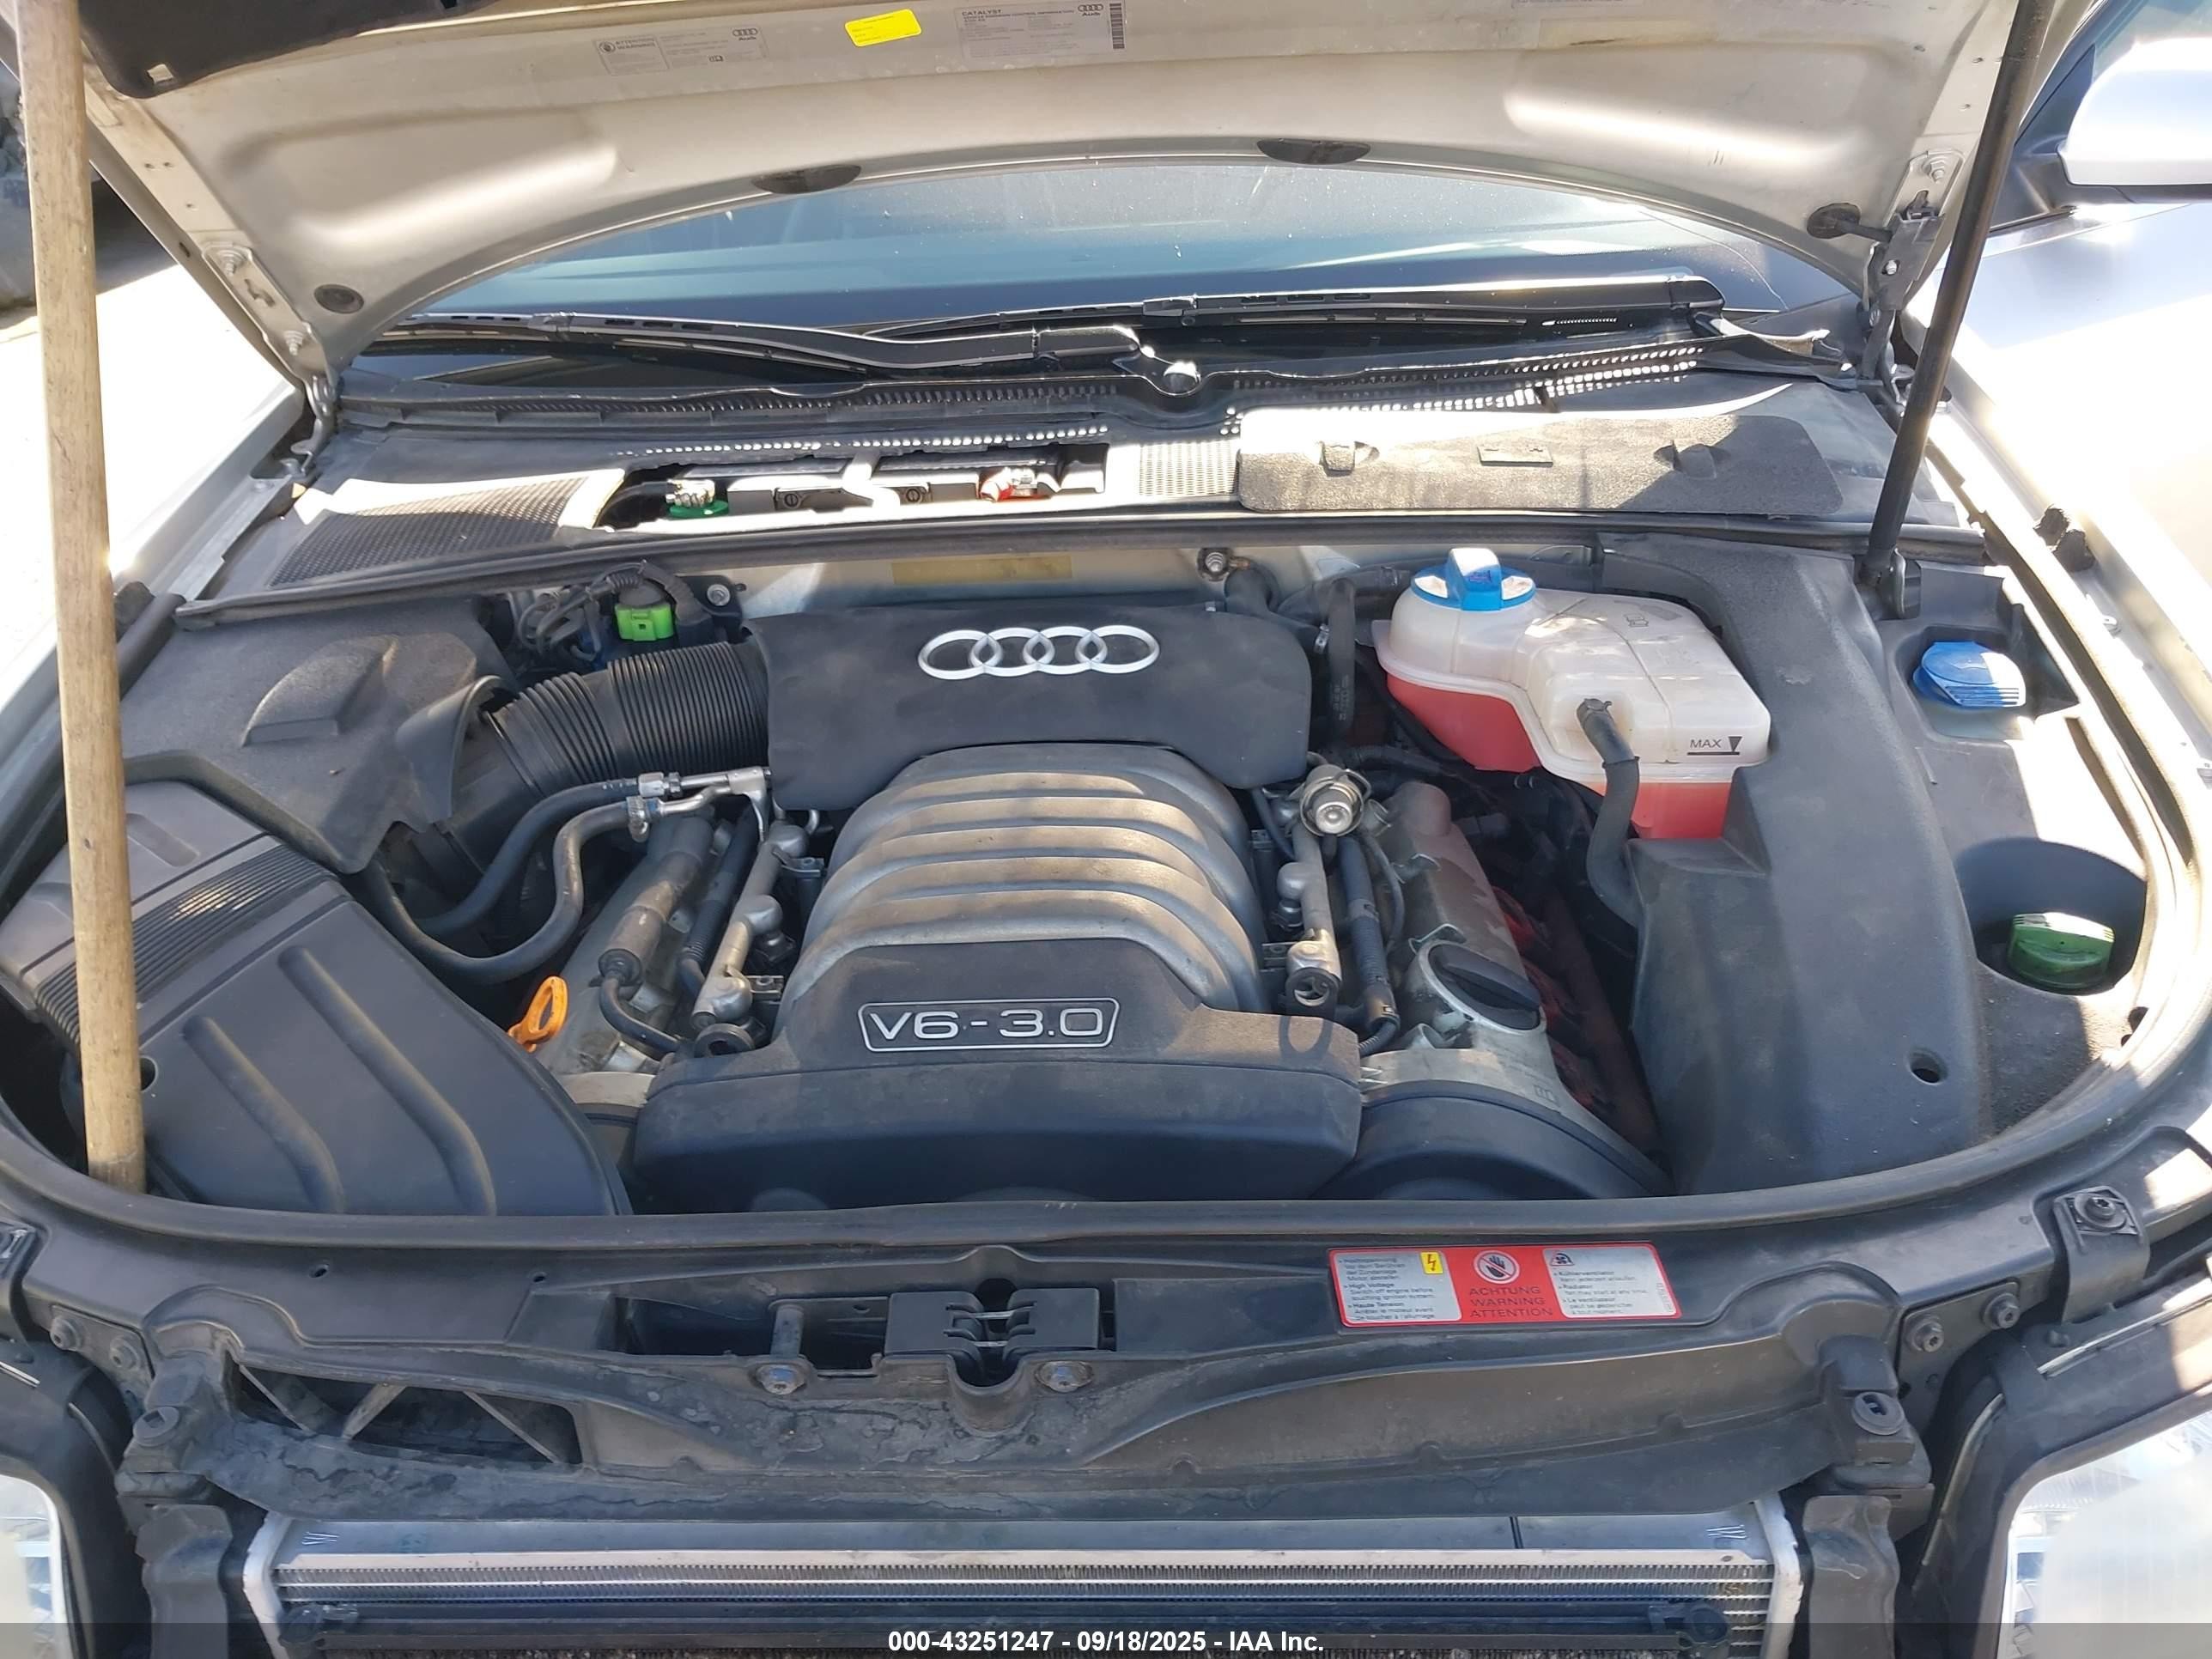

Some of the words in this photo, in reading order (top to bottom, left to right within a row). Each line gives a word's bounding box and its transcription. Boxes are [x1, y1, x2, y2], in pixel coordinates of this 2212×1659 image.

[1690, 739, 1722, 748] MAX
[1470, 1286, 1540, 1295] ACHTUNG
[1470, 1297, 1546, 1306] WARNING
[1470, 1308, 1553, 1317] ATTENTION
